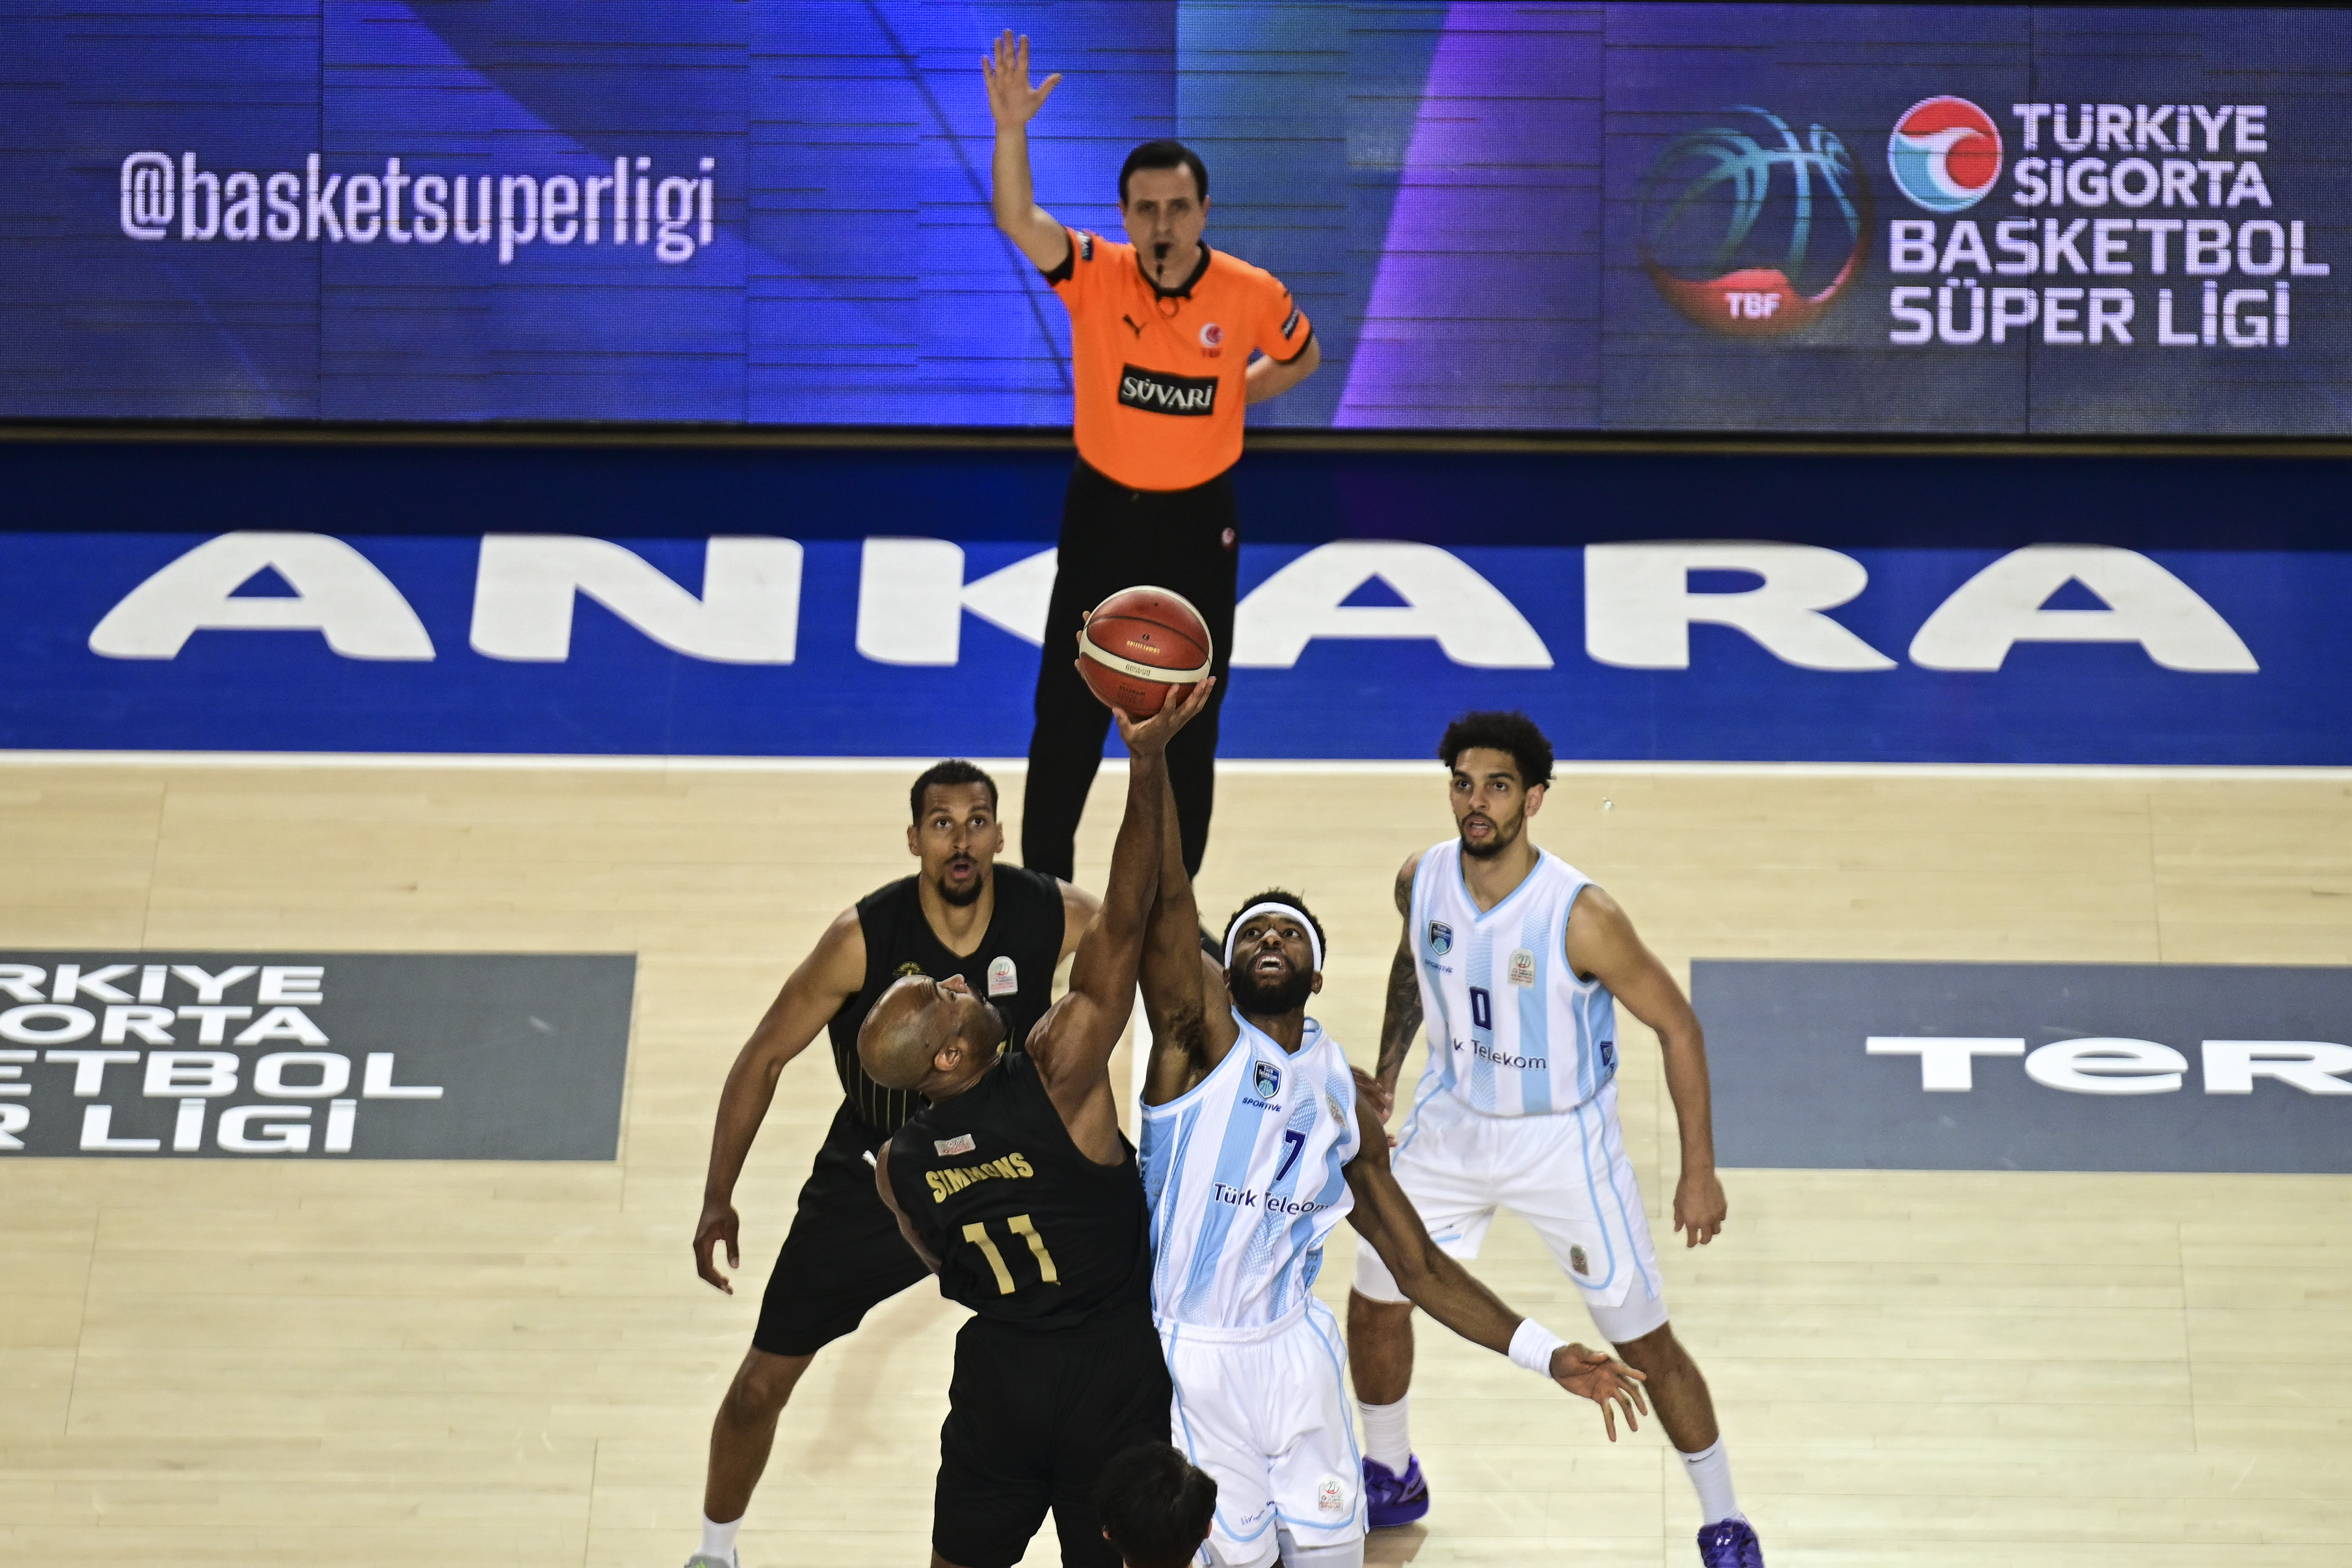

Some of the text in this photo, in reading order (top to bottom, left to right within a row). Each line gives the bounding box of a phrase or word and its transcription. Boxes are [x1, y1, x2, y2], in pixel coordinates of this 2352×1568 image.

[2013, 103, 2267, 153] TÜRKİYE
[120, 152, 715, 263] @basketsuperligi
[2012, 157, 2272, 207] SİGORTA
[1890, 219, 2330, 276] BASKETBOL
[1725, 292, 1781, 319] TBF
[1889, 278, 2290, 347] SÜPER LİGİ
[1121, 376, 1214, 410] SÜVARİ
[89, 531, 2260, 673] ANKARA
[1469, 986, 1492, 1031] 0
[1259, 1069, 1277, 1080] Telekom
[1471, 1039, 1547, 1070] Telekom
[80, 1098, 358, 1153] LİGİ
[925, 1152, 1034, 1204] SIMMONS
[1275, 1128, 1307, 1182] 7
[1214, 1182, 1330, 1216] Türk Teleom
[961, 1214, 1062, 1296] 11
